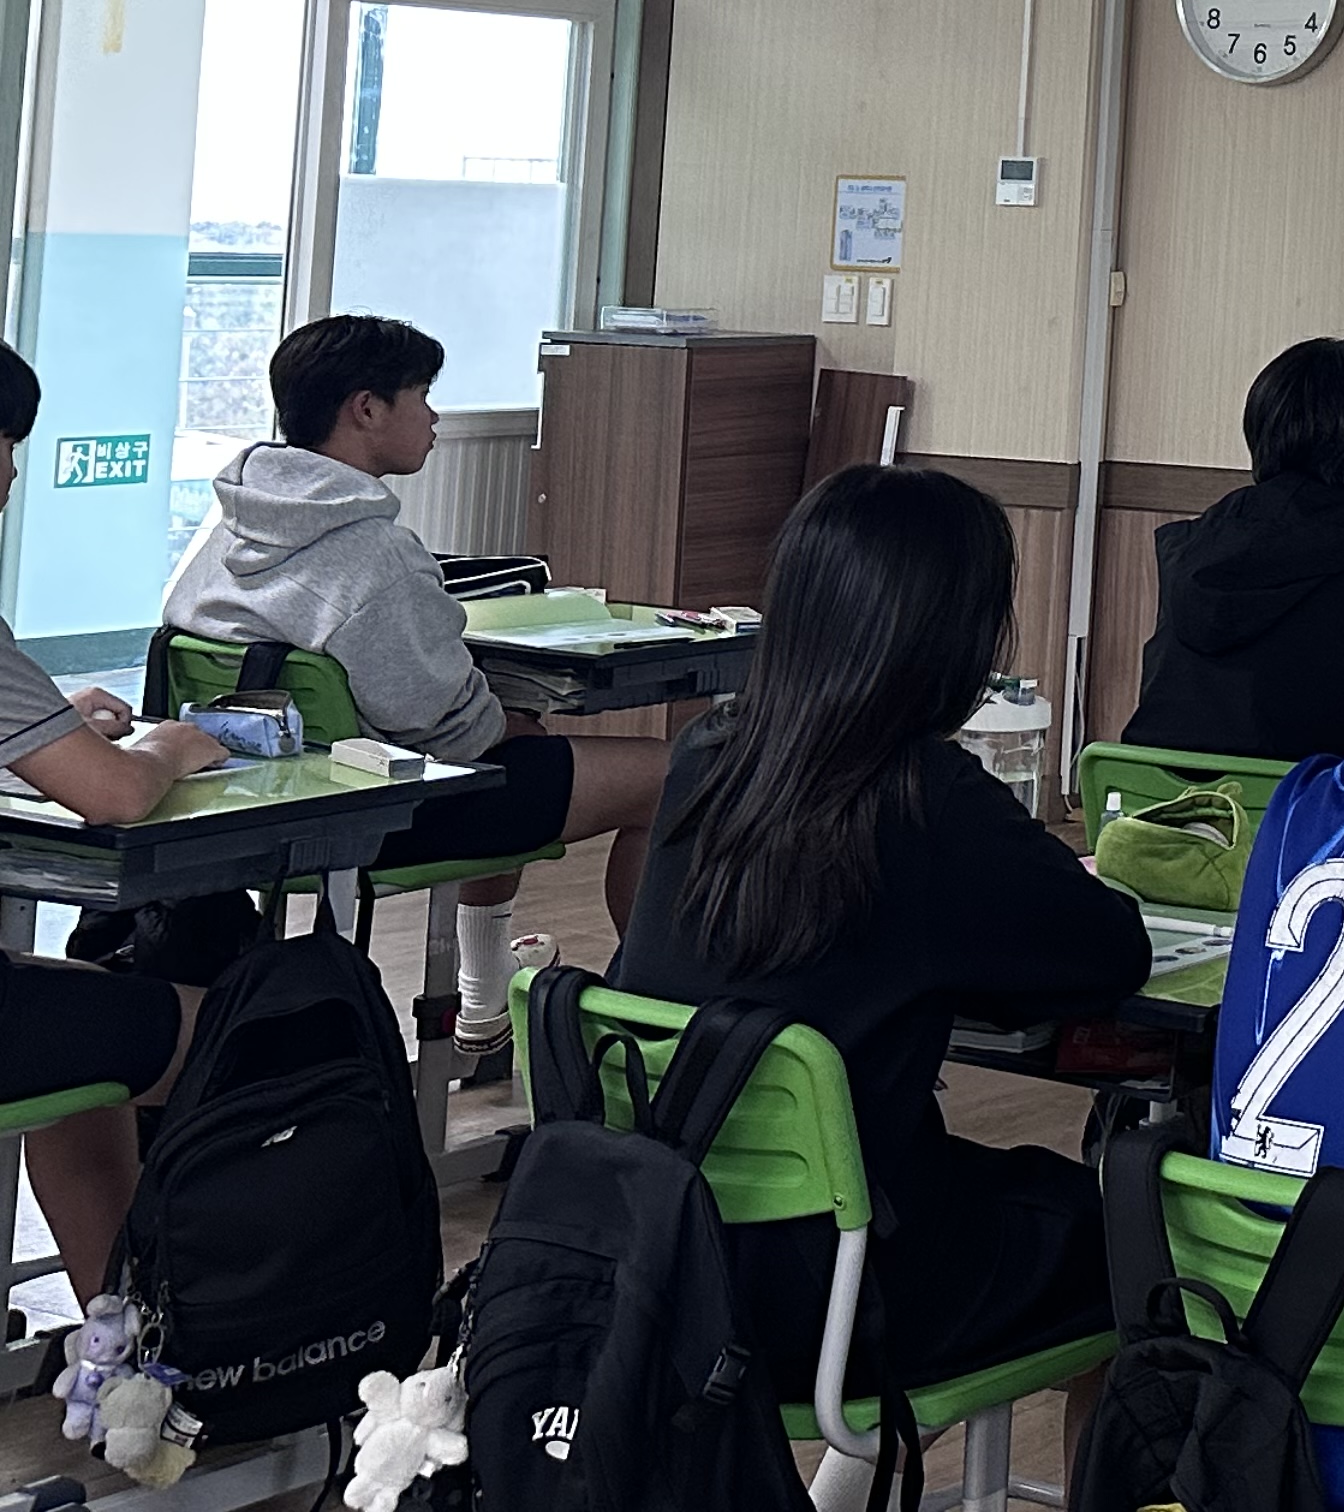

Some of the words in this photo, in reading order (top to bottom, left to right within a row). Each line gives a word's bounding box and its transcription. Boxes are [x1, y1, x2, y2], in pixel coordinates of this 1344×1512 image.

[1206, 8, 1220, 29] 8
[1304, 12, 1318, 33] 4
[1227, 34, 1241, 54] 7
[1254, 43, 1267, 64] 6
[1283, 35, 1296, 56] 5
[97, 441, 149, 460] 비상구
[95, 459, 146, 479] EXIT
[252, 1320, 386, 1383] balance
